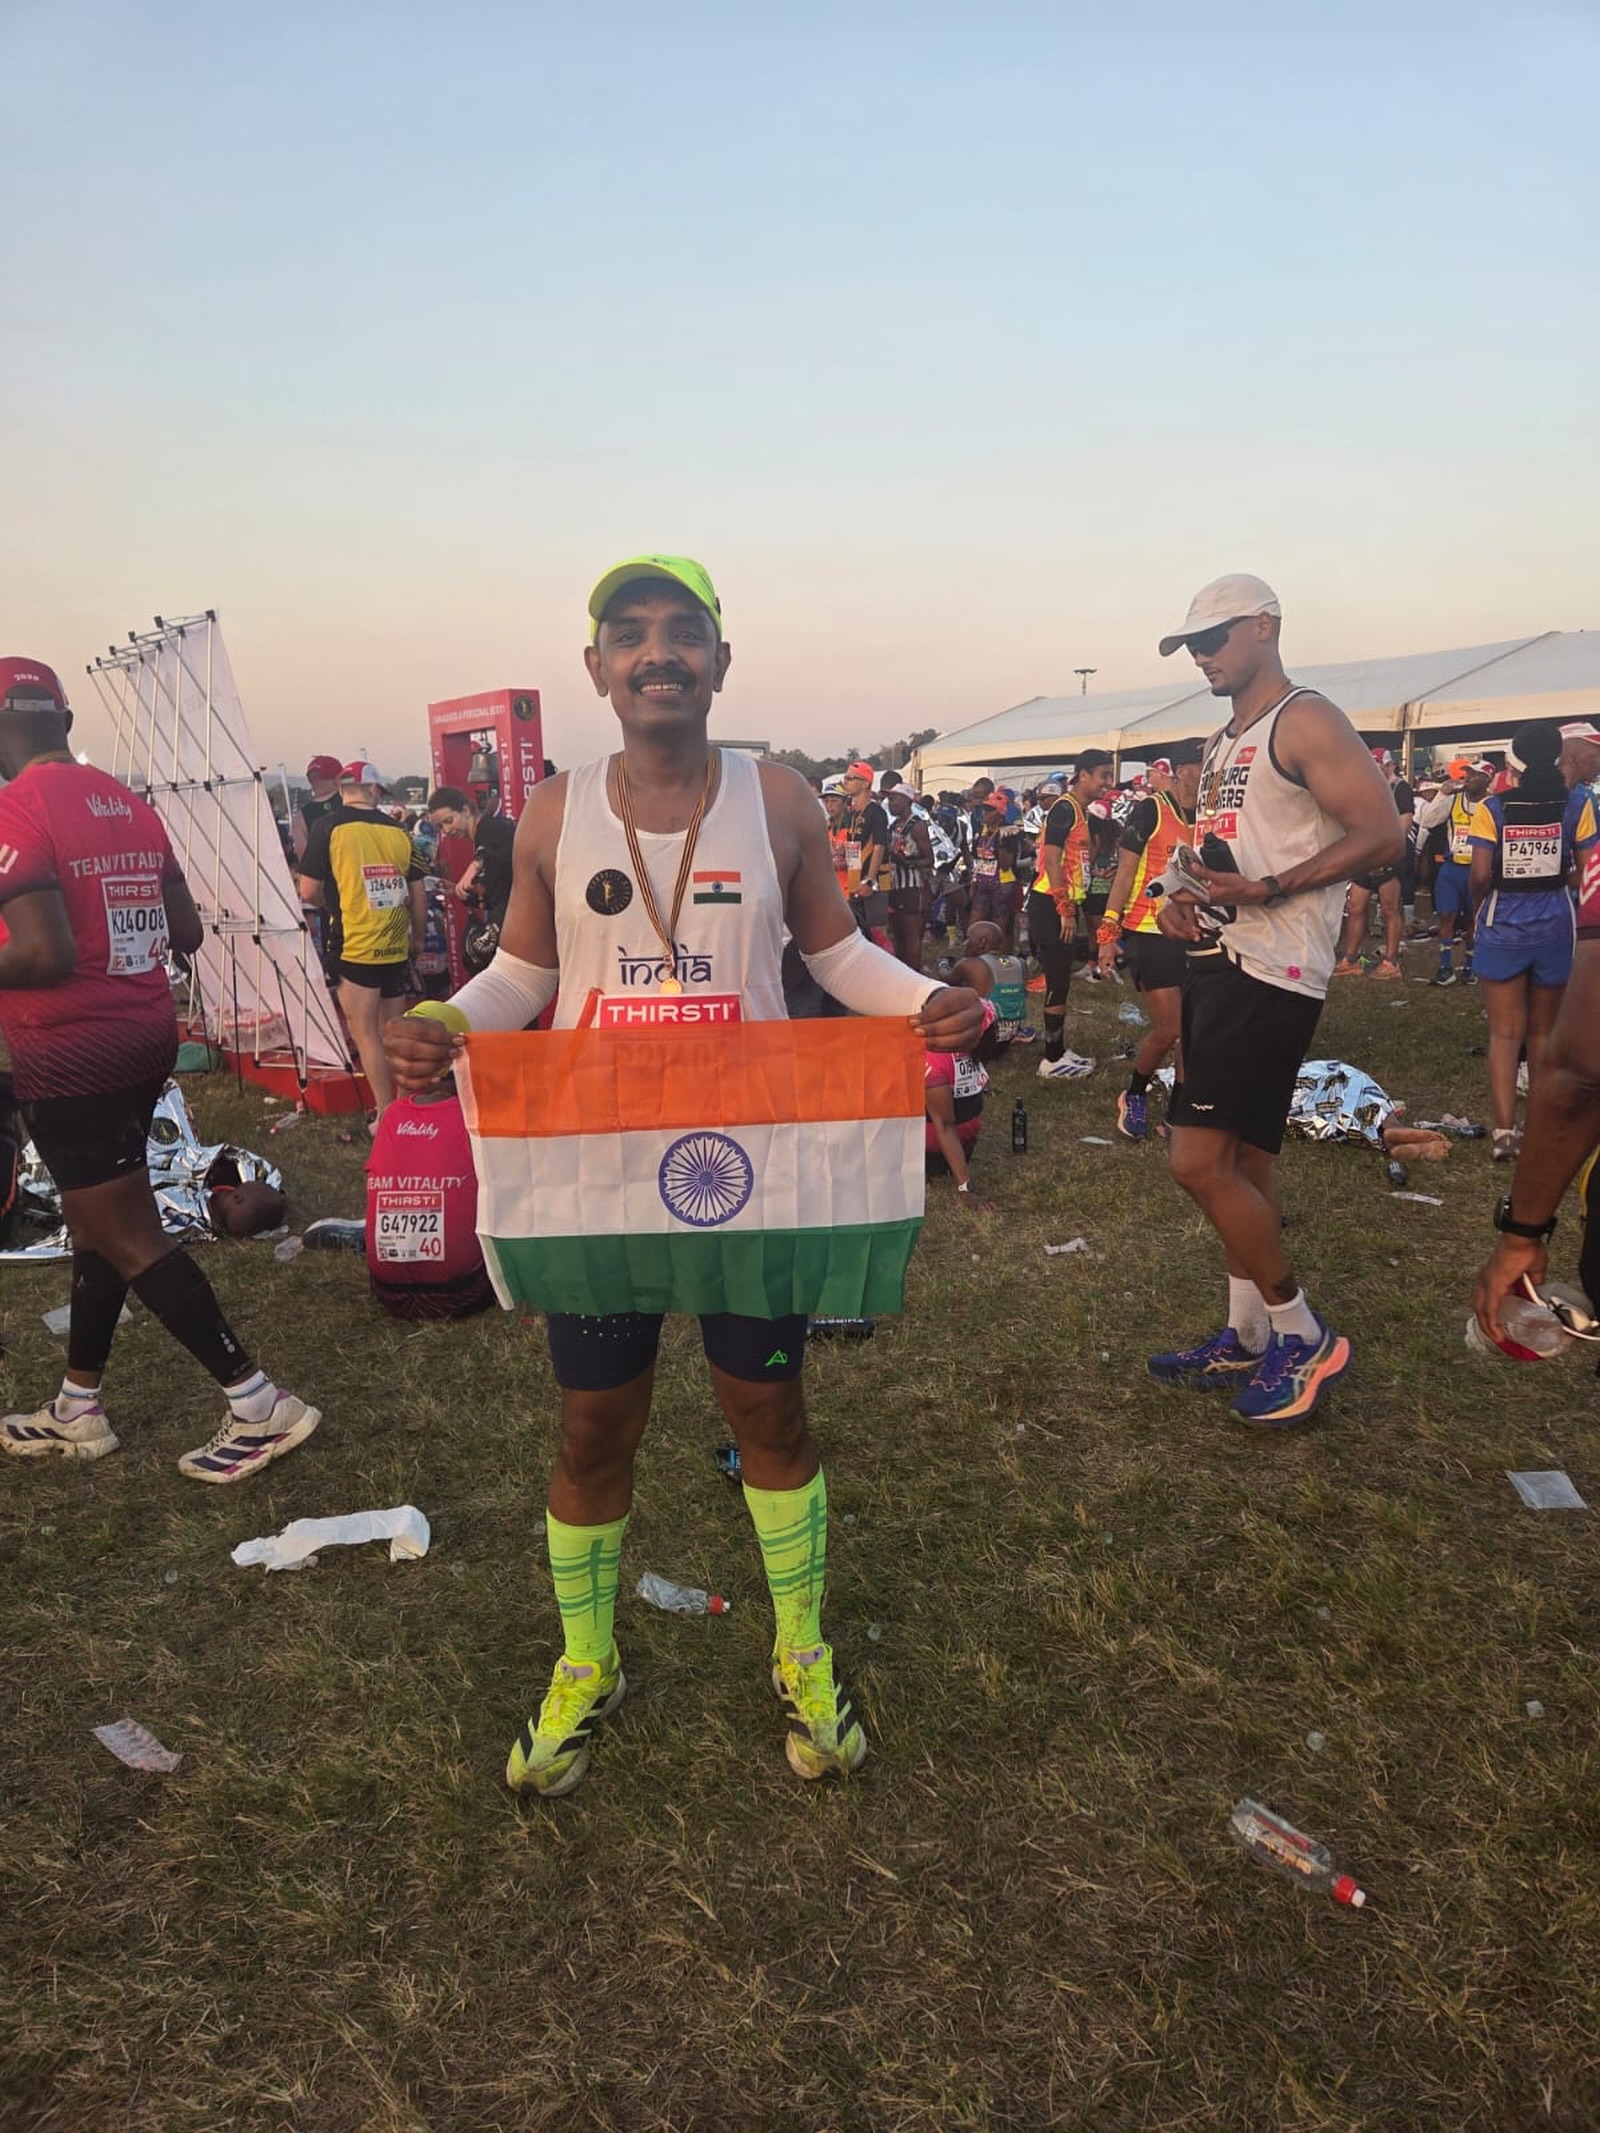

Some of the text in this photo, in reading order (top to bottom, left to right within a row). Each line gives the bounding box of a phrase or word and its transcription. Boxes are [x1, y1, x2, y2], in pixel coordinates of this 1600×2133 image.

[500, 741, 515, 820] HIRSTI
[520, 741, 537, 801] RSTI
[86, 792, 133, 823] Vitality
[1507, 827, 1556, 837] THIRSTI
[1510, 841, 1558, 857] P47966
[107, 885, 160, 897] THIRST
[111, 908, 166, 935] K24008
[617, 939, 713, 986] india
[607, 1003, 730, 1023] THIRSTI
[396, 1120, 438, 1140] Vitality
[367, 1174, 467, 1190] EAM VITALITY
[380, 1196, 437, 1206] THIRSTI
[381, 1214, 438, 1233] G47922
[419, 1237, 441, 1256] 40
